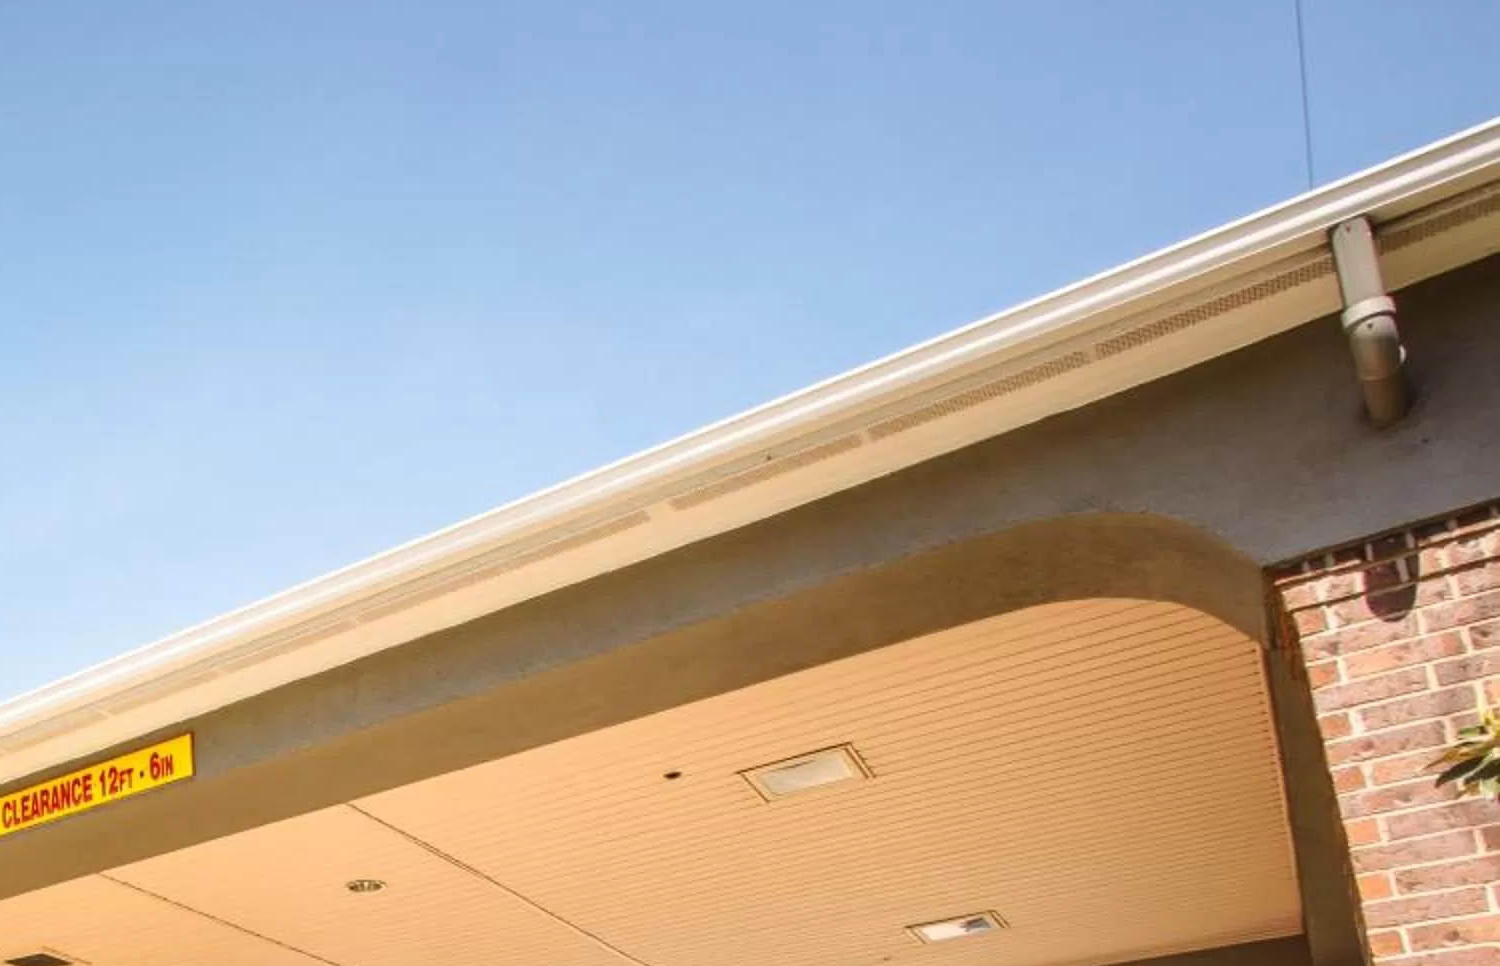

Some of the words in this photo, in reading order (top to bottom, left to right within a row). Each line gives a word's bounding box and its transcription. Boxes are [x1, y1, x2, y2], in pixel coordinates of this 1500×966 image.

[1, 773, 93, 829] CLEARANCE
[99, 766, 134, 797] 12FT
[150, 751, 174, 781] 6IN
